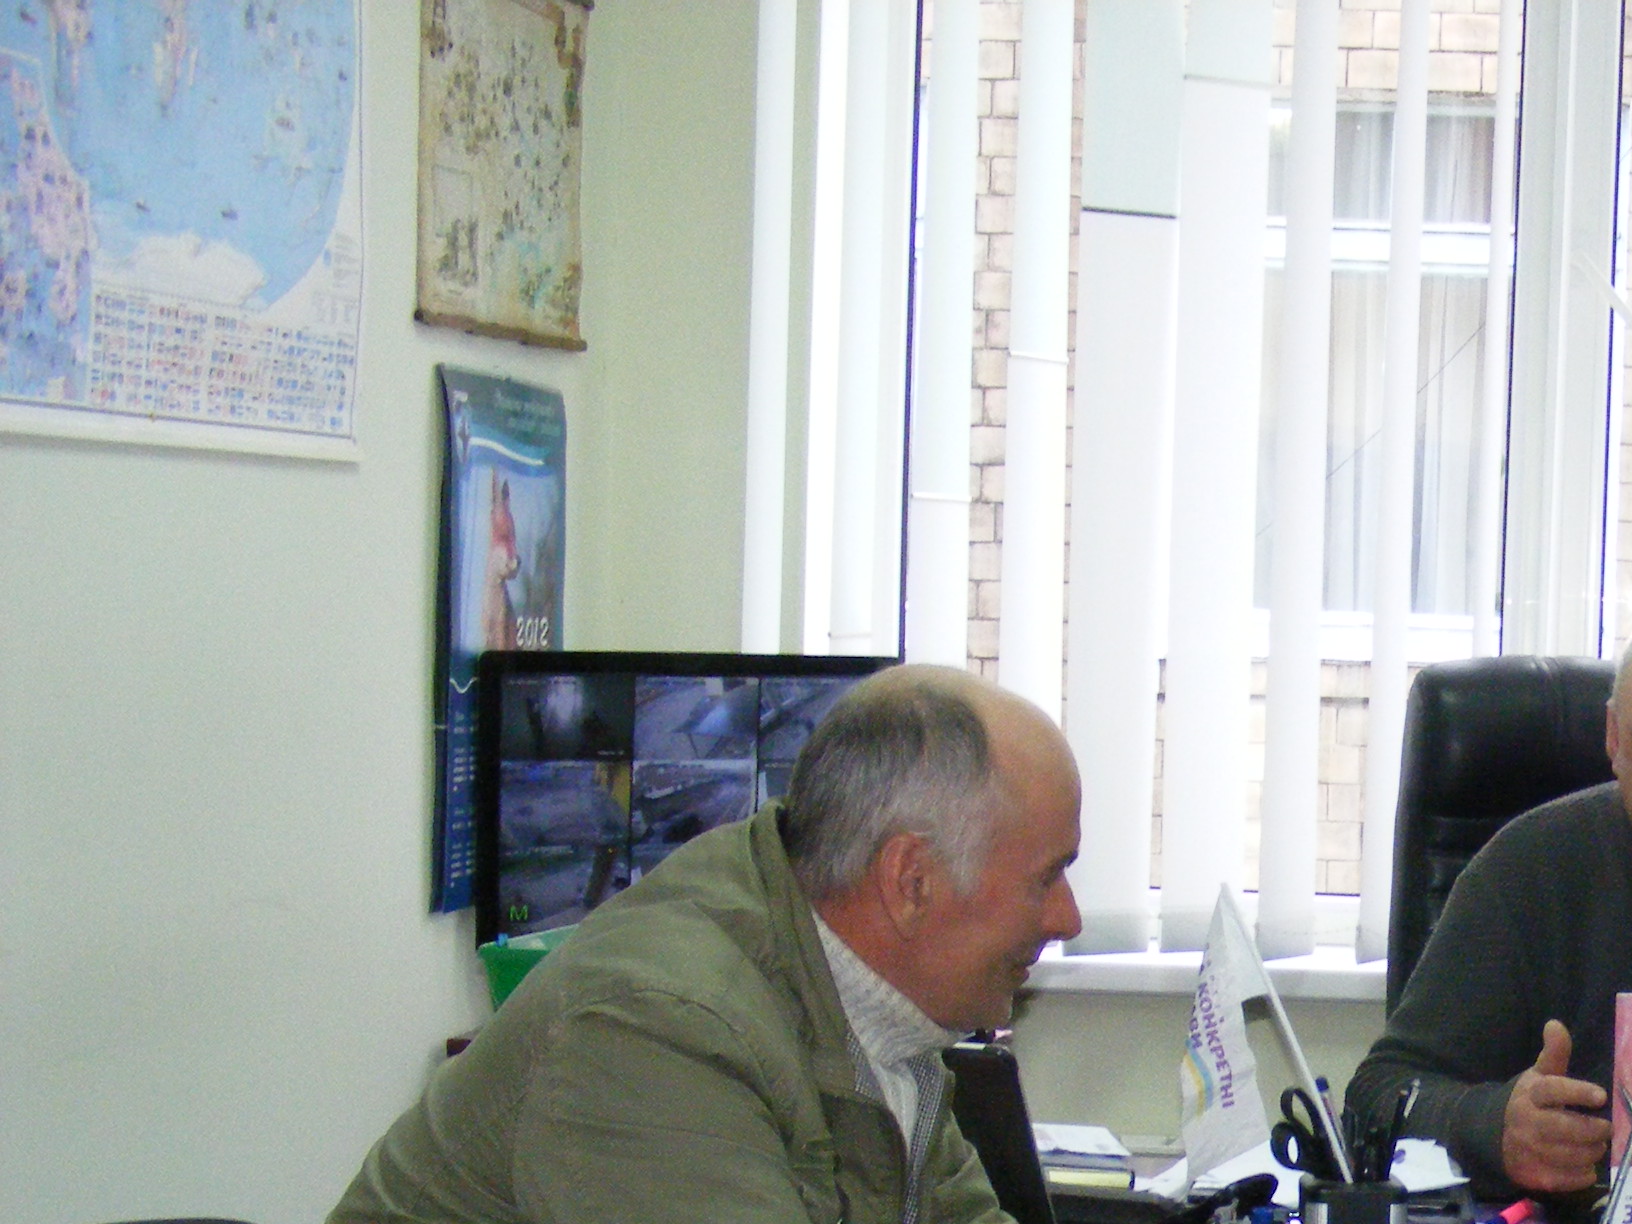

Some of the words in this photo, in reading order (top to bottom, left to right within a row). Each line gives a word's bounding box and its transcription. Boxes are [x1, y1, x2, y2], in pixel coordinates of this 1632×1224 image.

[516, 615, 549, 646] 2012
[510, 905, 528, 921] M
[1198, 981, 1235, 1109] КОНКРЕТНІ
